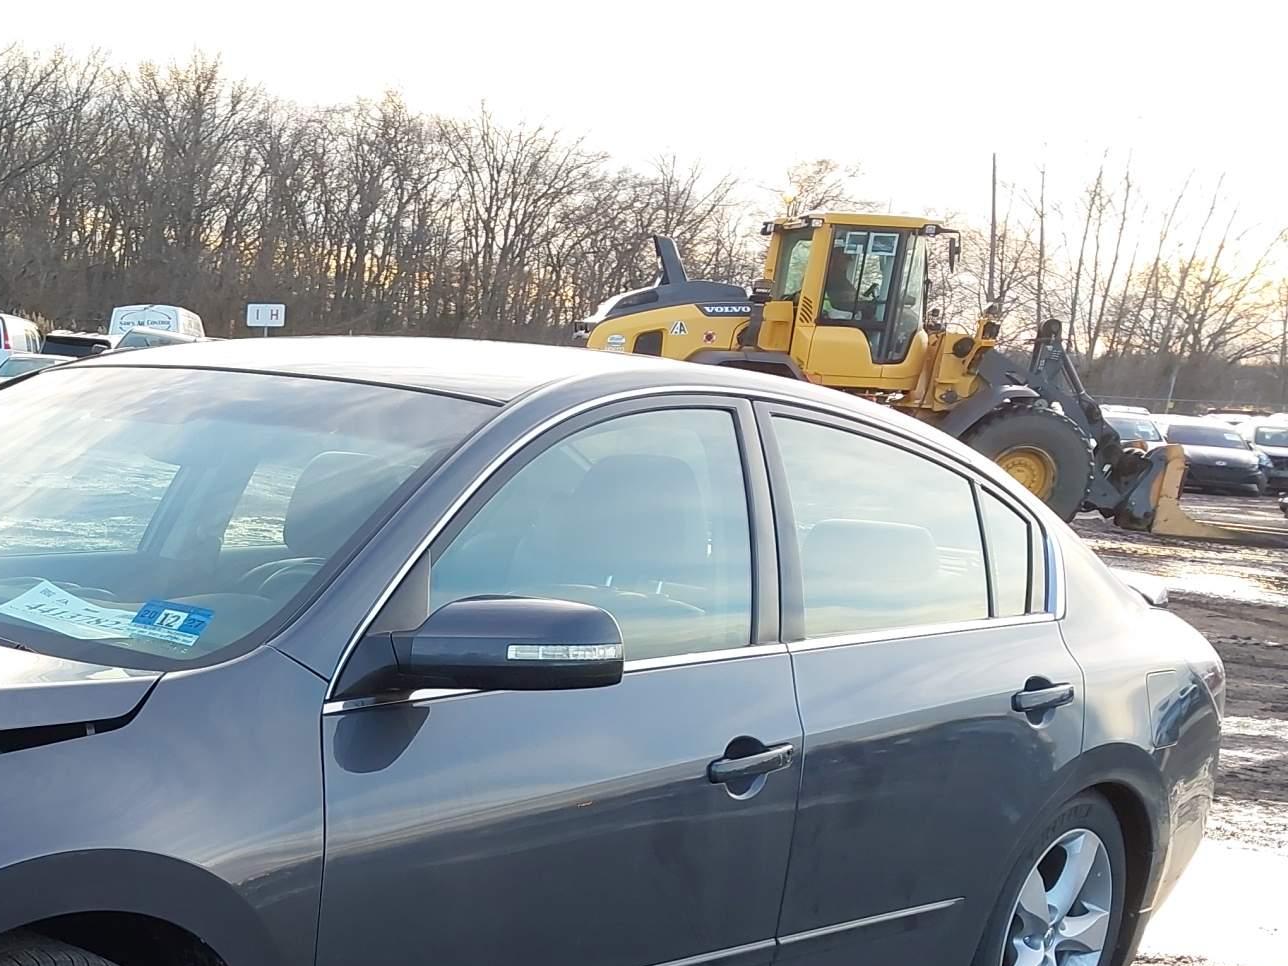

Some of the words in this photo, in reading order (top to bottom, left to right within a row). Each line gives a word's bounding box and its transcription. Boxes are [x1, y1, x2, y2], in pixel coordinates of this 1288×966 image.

[270, 309, 279, 320] H
[25, 603, 128, 631] 4413782
[140, 609, 158, 619] 20
[156, 612, 181, 628] 12
[184, 619, 205, 629] 27
